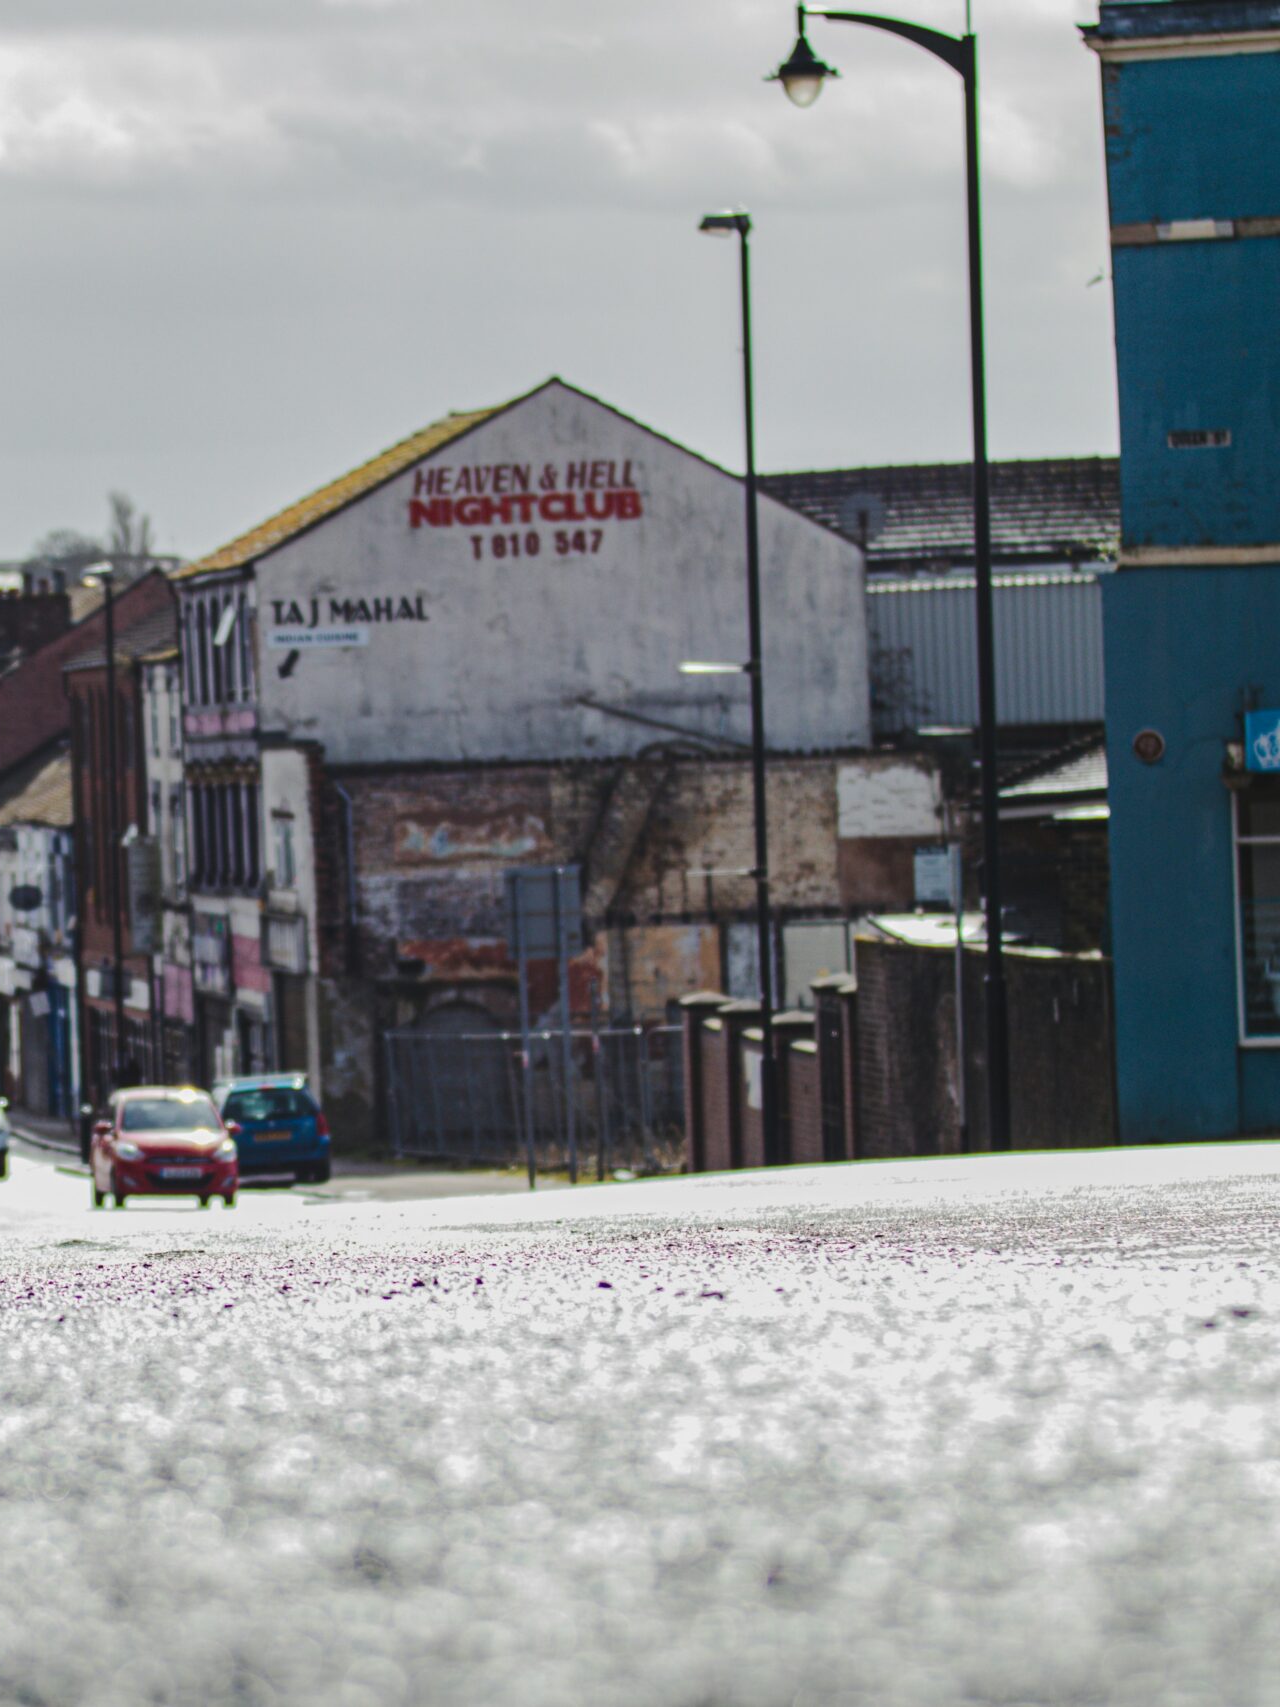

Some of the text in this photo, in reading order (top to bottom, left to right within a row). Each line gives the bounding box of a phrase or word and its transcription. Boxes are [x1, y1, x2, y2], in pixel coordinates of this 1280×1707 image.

[414, 459, 635, 495] HEAVEN & HELL
[409, 488, 643, 528] NIGHTCLUB
[471, 529, 603, 560] T 810 547
[271, 596, 430, 628] TAJ MAHAL
